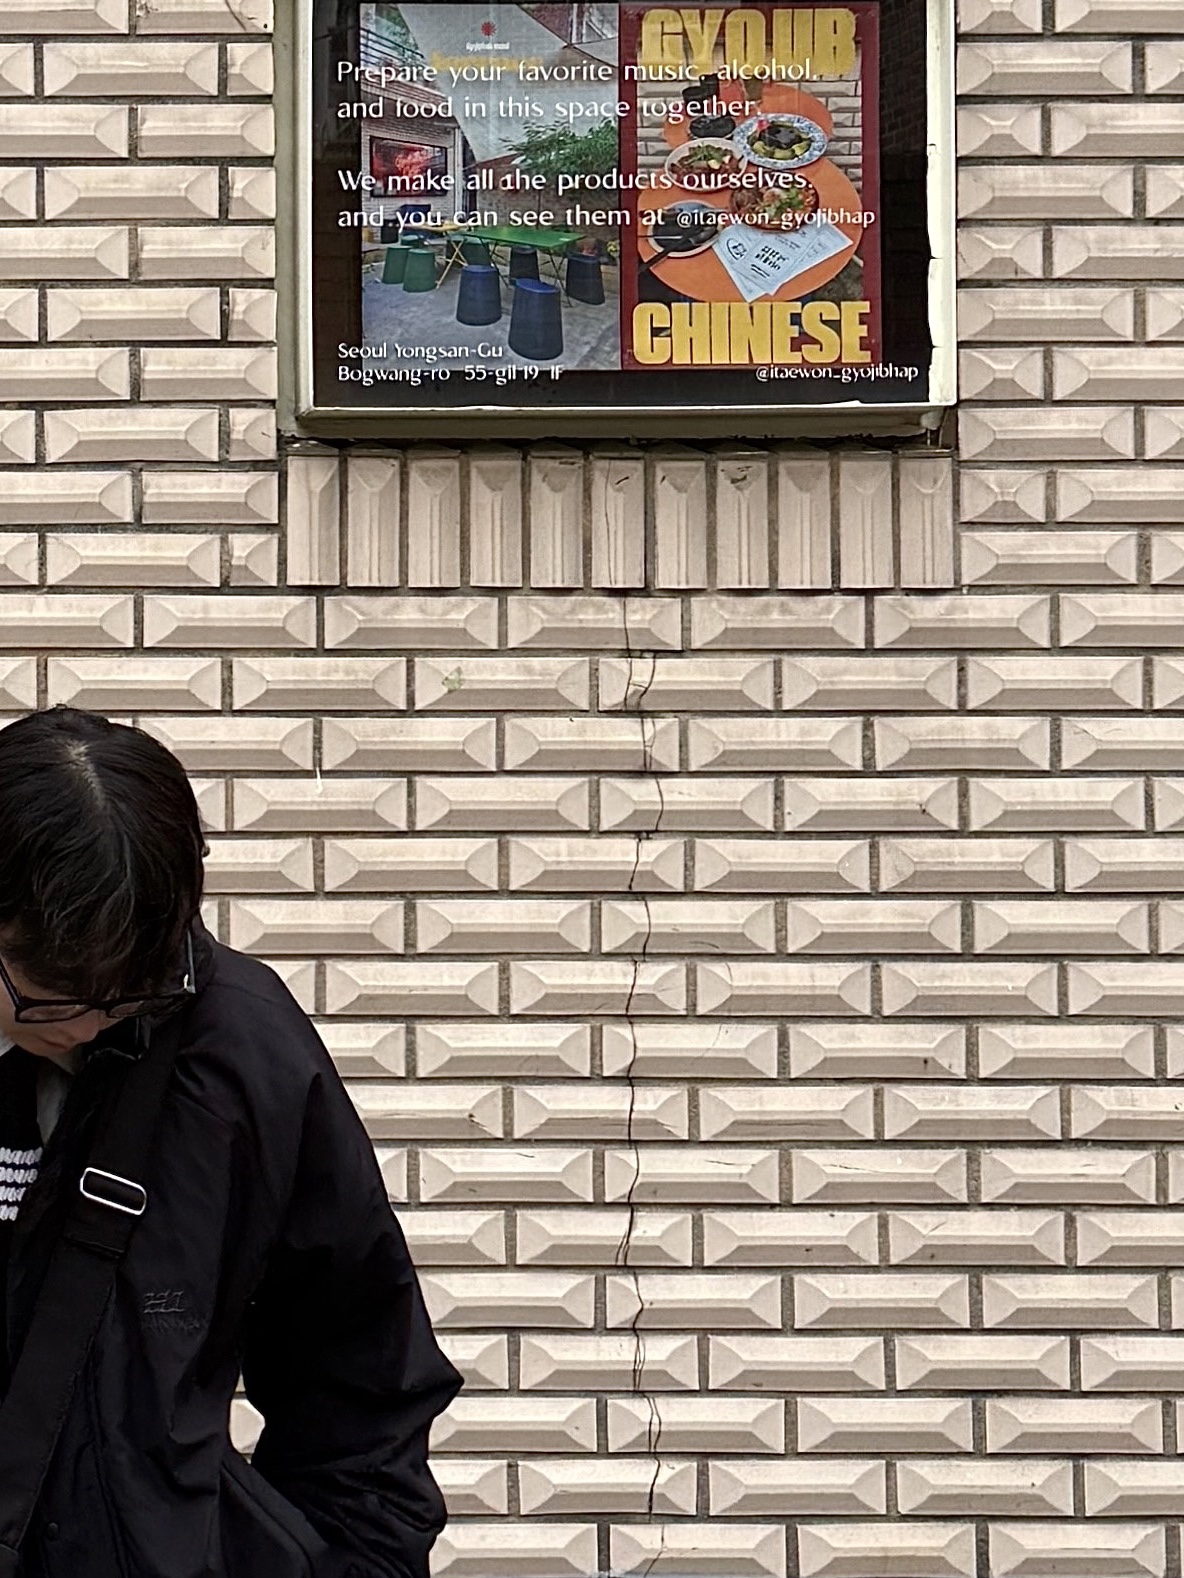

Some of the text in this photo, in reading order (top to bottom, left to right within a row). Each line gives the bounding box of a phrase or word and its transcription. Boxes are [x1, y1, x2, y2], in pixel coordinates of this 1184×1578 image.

[337, 61, 437, 88] Prepare
[450, 65, 507, 88] your
[519, 60, 613, 81] favorite
[337, 95, 762, 124] and food in this space together.
[338, 168, 813, 196] We make all the products ourselves.
[338, 204, 875, 232] and you can see them at @itaewon_gyojibhap
[632, 302, 872, 365] CHINESE
[338, 342, 503, 363] Seoul Yongsan-Gu
[338, 366, 451, 386] Bogwang-ro
[465, 365, 516, 386] 55-gil
[523, 364, 539, 380] 19
[756, 363, 919, 383] @itaewon_gyojibhap
